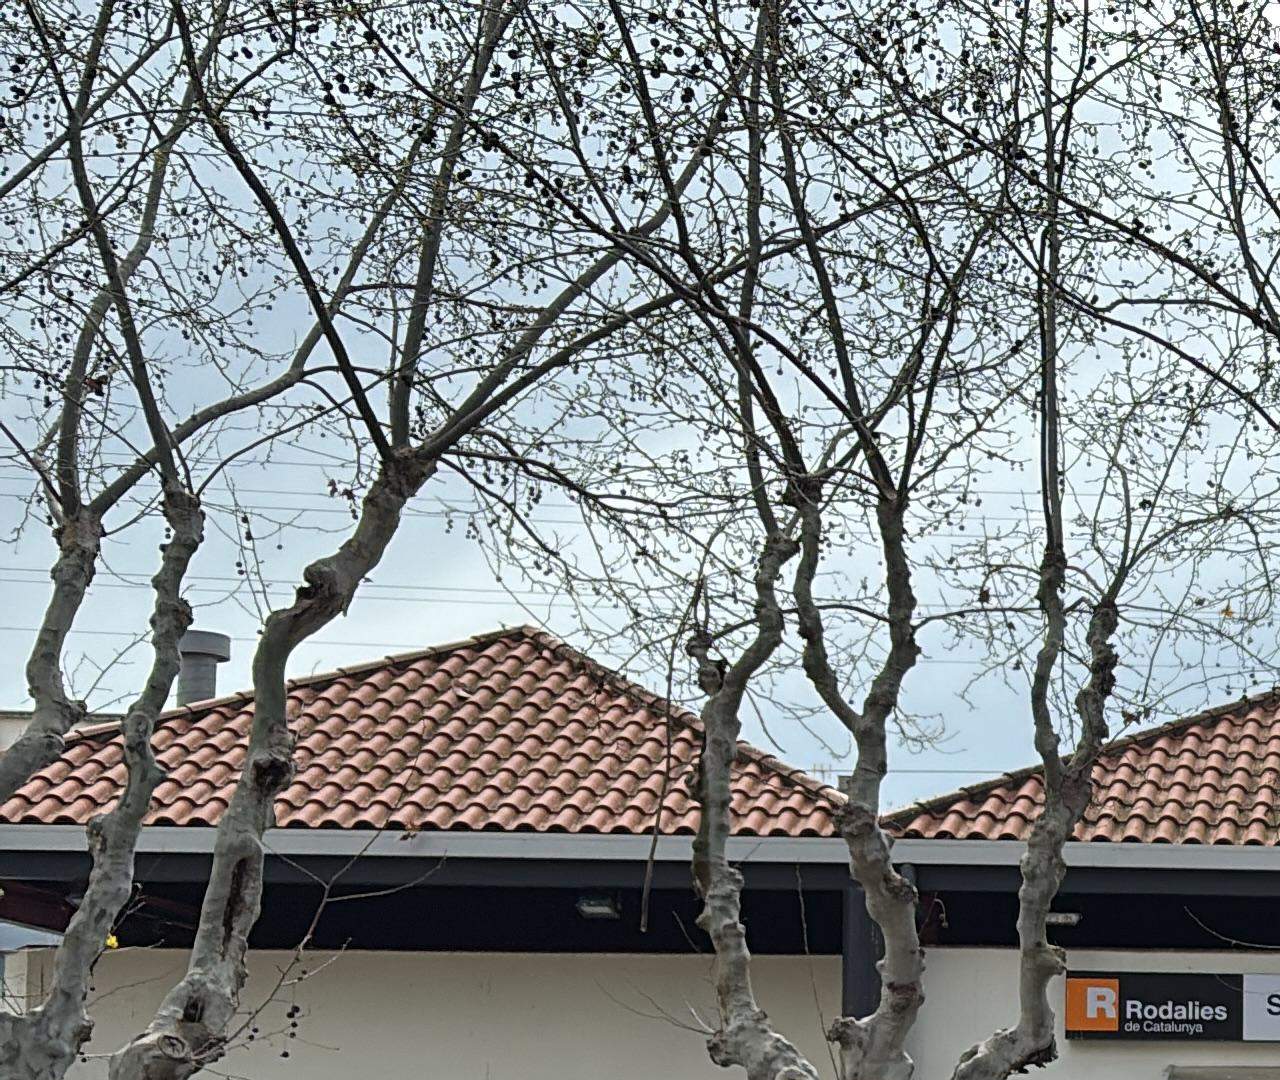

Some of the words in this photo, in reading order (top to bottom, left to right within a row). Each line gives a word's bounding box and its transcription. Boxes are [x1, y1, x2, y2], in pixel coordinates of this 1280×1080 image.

[1086, 986, 1117, 1018] R
[1126, 1000, 1228, 1021] Rodalies
[1125, 1021, 1141, 1033] de
[1143, 1021, 1204, 1035] Catalunya
